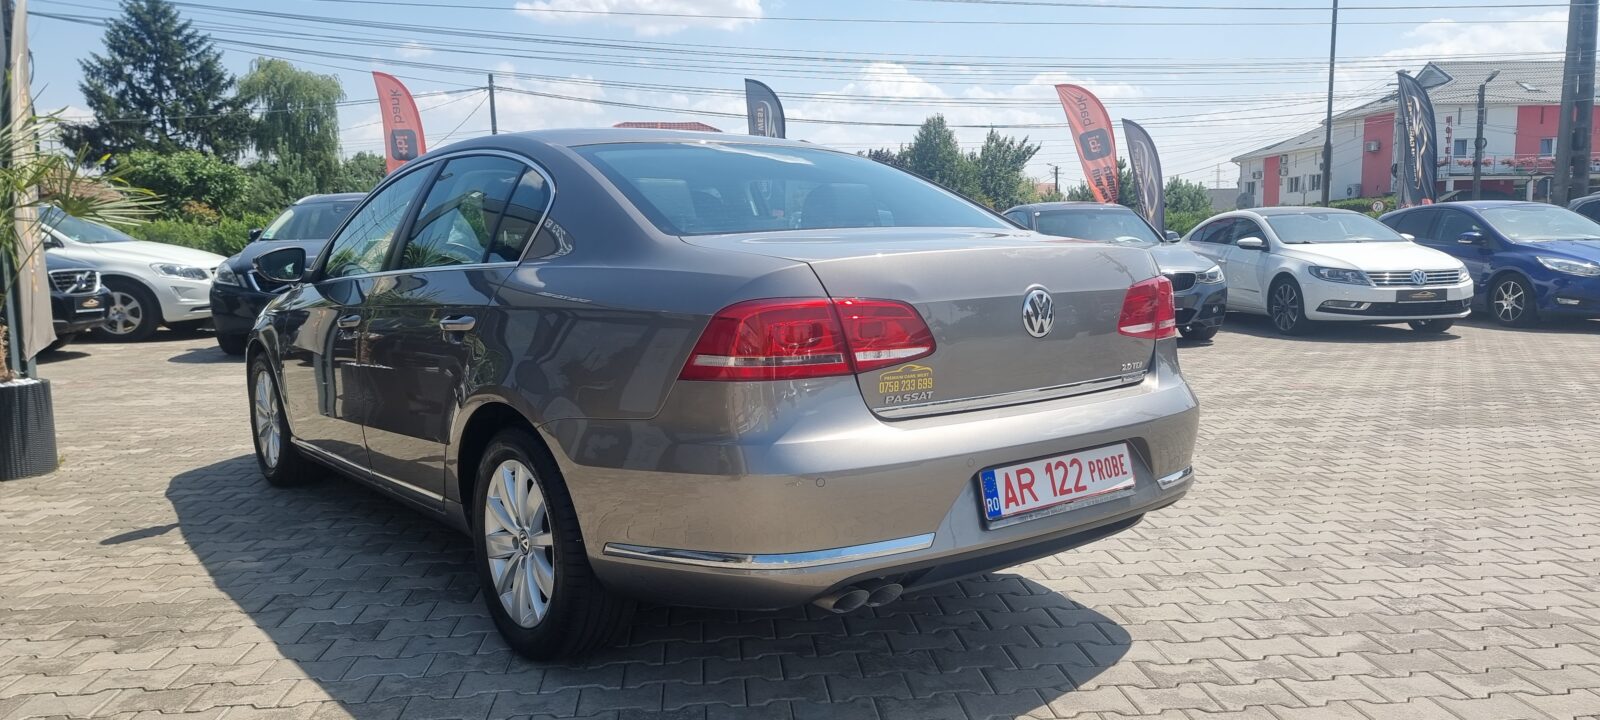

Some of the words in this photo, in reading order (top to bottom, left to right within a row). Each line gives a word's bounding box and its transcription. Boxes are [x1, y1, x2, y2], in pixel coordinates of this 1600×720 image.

[879, 381, 899, 393] 0758
[901, 379, 915, 391] 233
[918, 377, 933, 389] 699
[885, 391, 934, 404] PASSAT
[986, 497, 1000, 513] RO
[1004, 467, 1039, 510] AR
[1044, 457, 1088, 497] 122
[1087, 453, 1128, 483] PROBE
